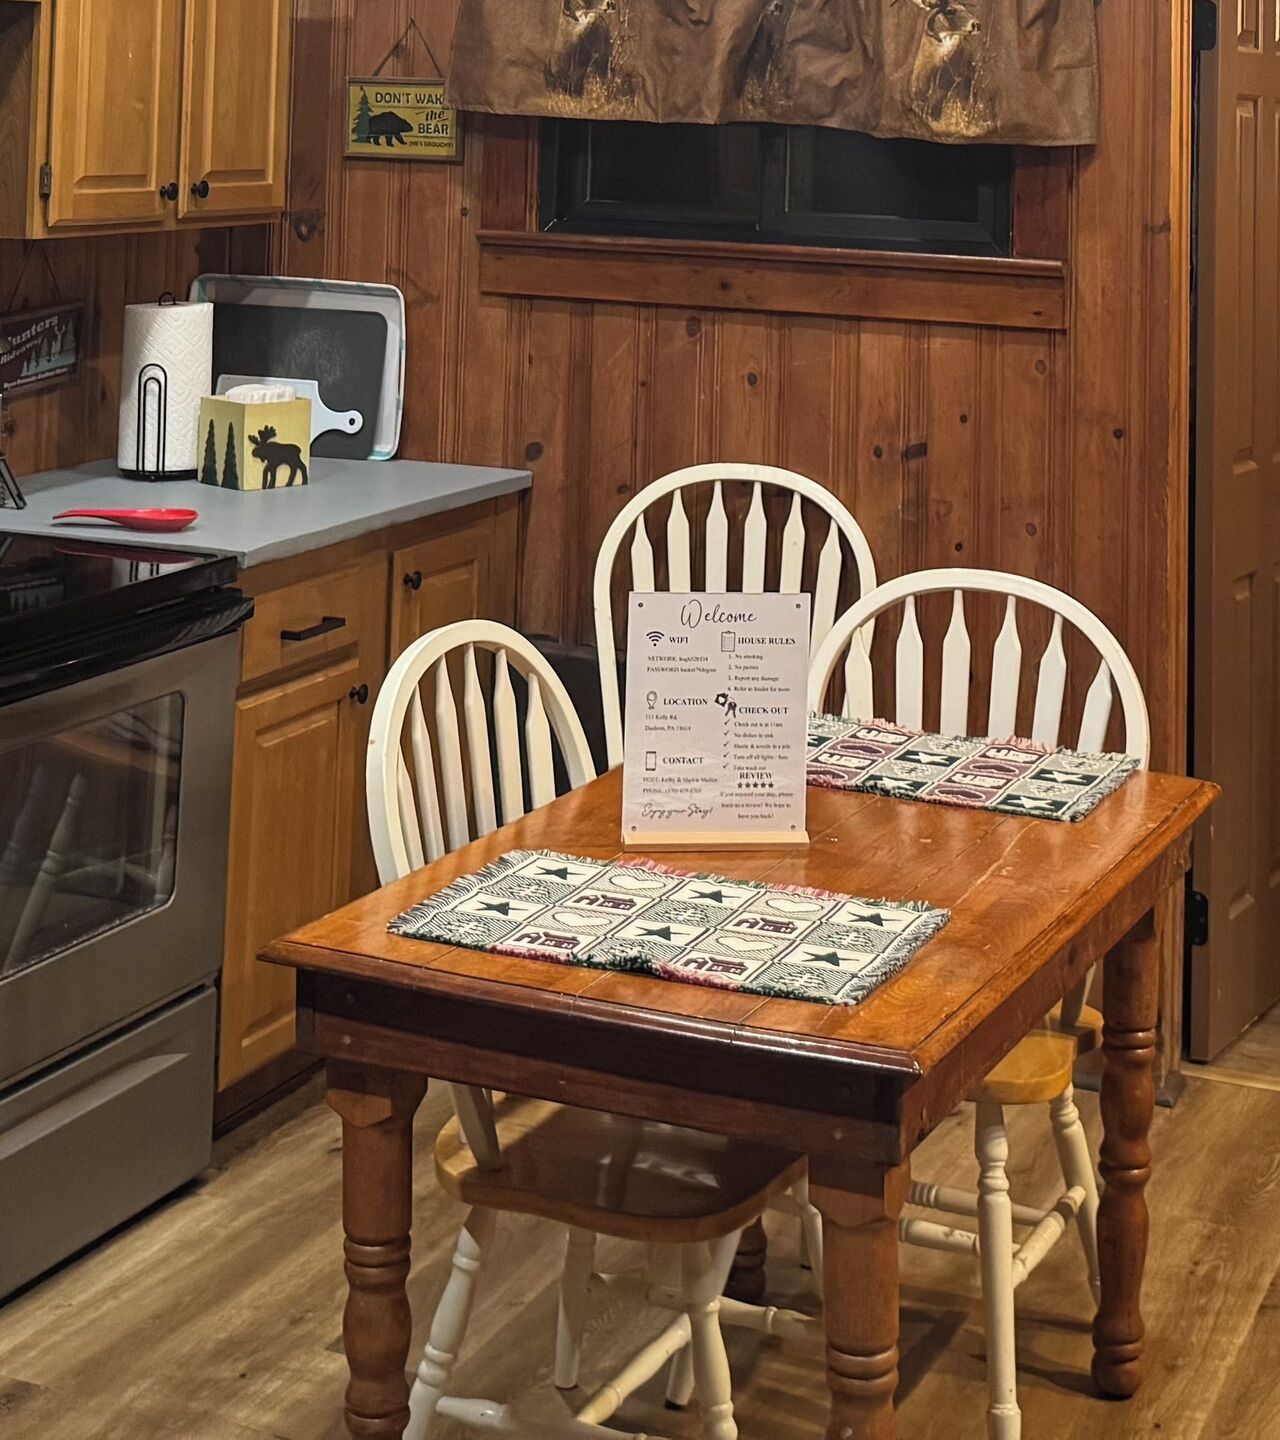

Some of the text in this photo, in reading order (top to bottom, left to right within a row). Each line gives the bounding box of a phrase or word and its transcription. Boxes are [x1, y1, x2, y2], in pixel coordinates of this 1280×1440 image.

[375, 92, 444, 105] DON'T WAK
[425, 110, 445, 122] the
[418, 123, 448, 135] BEAR
[8, 315, 58, 346] unters
[681, 599, 757, 628] Welcome
[669, 636, 689, 644] WIFI
[738, 637, 796, 645] HOUSE RULES
[663, 698, 708, 706] LOCATION
[739, 706, 789, 714] CHECK OUT
[662, 757, 704, 765] CONTACT
[739, 771, 773, 780] REVIEW
